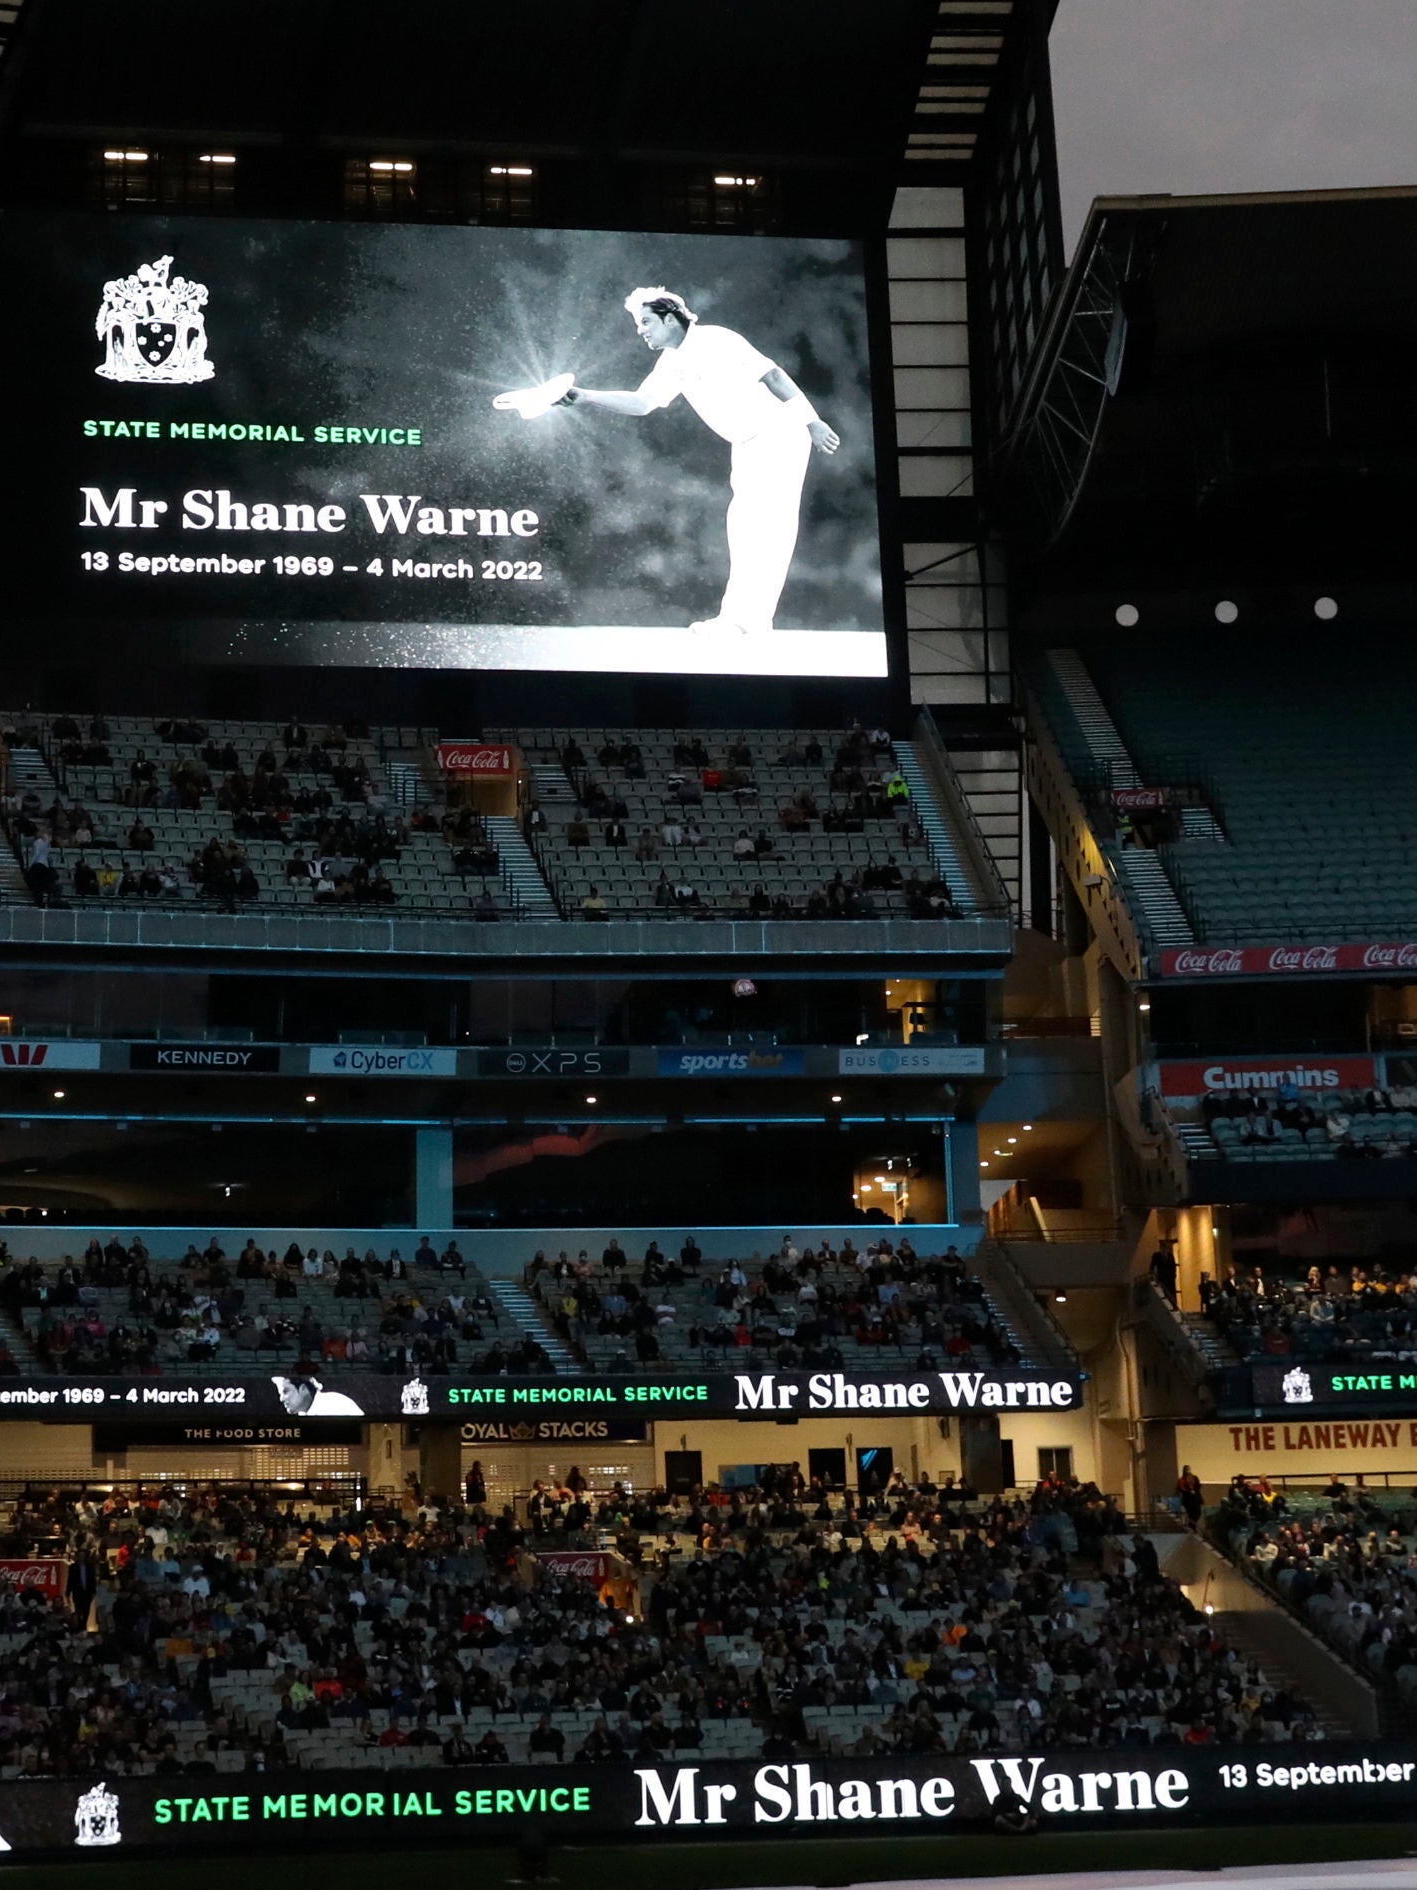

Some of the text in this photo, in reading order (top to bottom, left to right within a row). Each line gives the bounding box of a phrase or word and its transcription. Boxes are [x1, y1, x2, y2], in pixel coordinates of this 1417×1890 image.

[83, 419, 423, 446] STATE MEMORIAL SERVICE
[79, 487, 539, 537] Mr Shane Warne
[80, 551, 110, 571] 13
[118, 552, 267, 576] September
[272, 555, 334, 576] 1969
[366, 557, 384, 577] 4
[391, 558, 474, 579] March
[481, 561, 543, 581] 2022
[446, 750, 501, 769] Coca-Cola
[1175, 949, 1243, 973] Coca-Cola
[1269, 946, 1339, 970] Coca-Cola
[157, 1050, 252, 1066] KENNEDY
[351, 1050, 433, 1073] CyberCX
[1203, 1065, 1339, 1090] Cummins
[448, 1385, 708, 1404] STATE MEMORIAL SERVICE
[734, 1372, 1073, 1410] Mr Shane Warne
[1331, 1374, 1417, 1391] STATE M
[62, 1387, 105, 1404] 1969
[125, 1387, 138, 1404] 4
[143, 1387, 199, 1404] March
[203, 1387, 246, 1404] 2022
[185, 1428, 210, 1438] THE
[258, 1428, 301, 1438] STORE
[460, 1421, 609, 1439] OYAL STACKS
[1229, 1425, 1277, 1452] THE
[1284, 1422, 1402, 1450] LANEWAY
[1218, 1758, 1416, 1791] 13 September
[633, 1756, 1189, 1827] Mr Shane Warne
[154, 1787, 590, 1824] STATE MEMORIAL SERVICE
